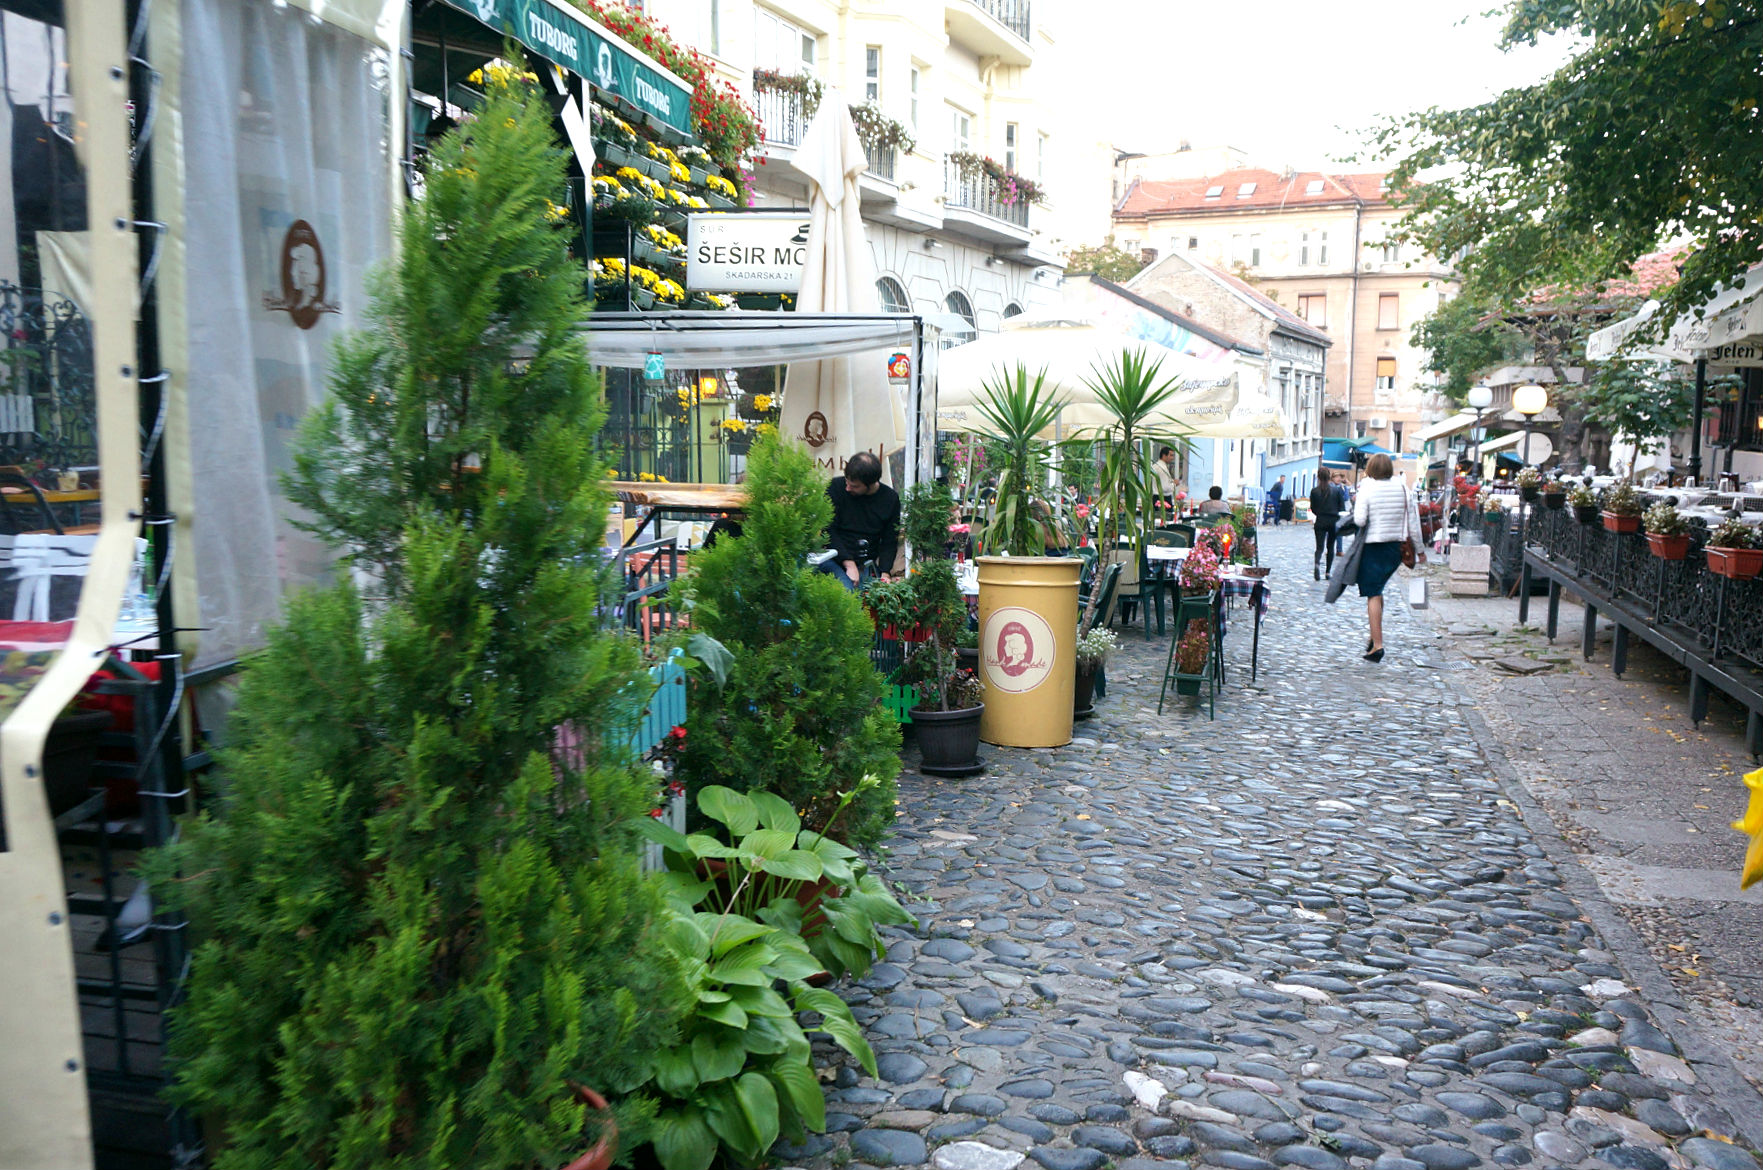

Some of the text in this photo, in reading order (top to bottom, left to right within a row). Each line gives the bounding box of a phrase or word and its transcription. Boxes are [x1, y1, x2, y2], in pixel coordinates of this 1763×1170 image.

[528, 10, 578, 61] TUBORG
[635, 75, 670, 116] TUBORG
[697, 240, 766, 265] ŠEŠIR
[725, 270, 793, 280] SKADARSKA 21
[1711, 342, 1755, 361] Jelen
